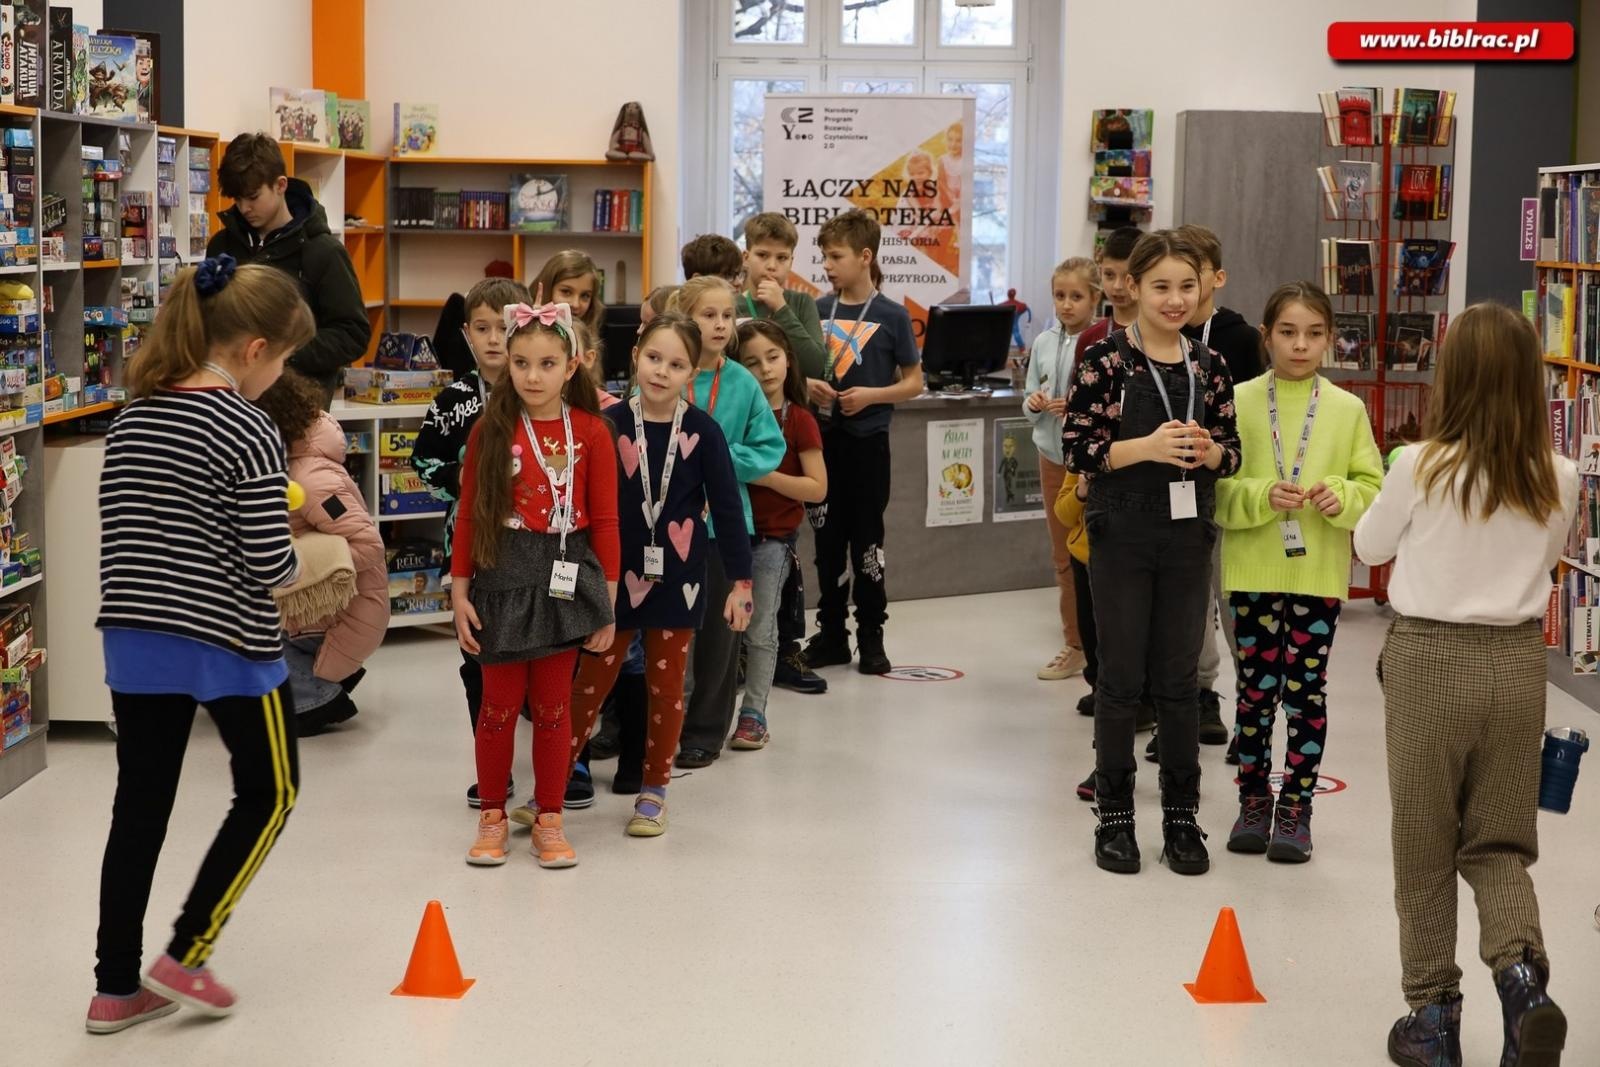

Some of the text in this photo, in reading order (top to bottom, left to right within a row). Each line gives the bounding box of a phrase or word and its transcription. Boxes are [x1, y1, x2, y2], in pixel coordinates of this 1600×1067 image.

[20, 46, 28, 93] ATAKUJE
[23, 41, 38, 98] IMPERIUM
[52, 40, 64, 110] ARMADA
[824, 116, 853, 124] Program
[783, 179, 938, 201] ŁĄCZY NAS
[1410, 170, 1430, 190] LORE
[1525, 209, 1534, 250] SZTUKA
[882, 237, 941, 247] HISTORIA
[882, 256, 918, 265] PASJA
[882, 274, 947, 284] PRZYRODA
[1553, 408, 1563, 456] MUZYKA
[396, 556, 425, 570] RELIC
